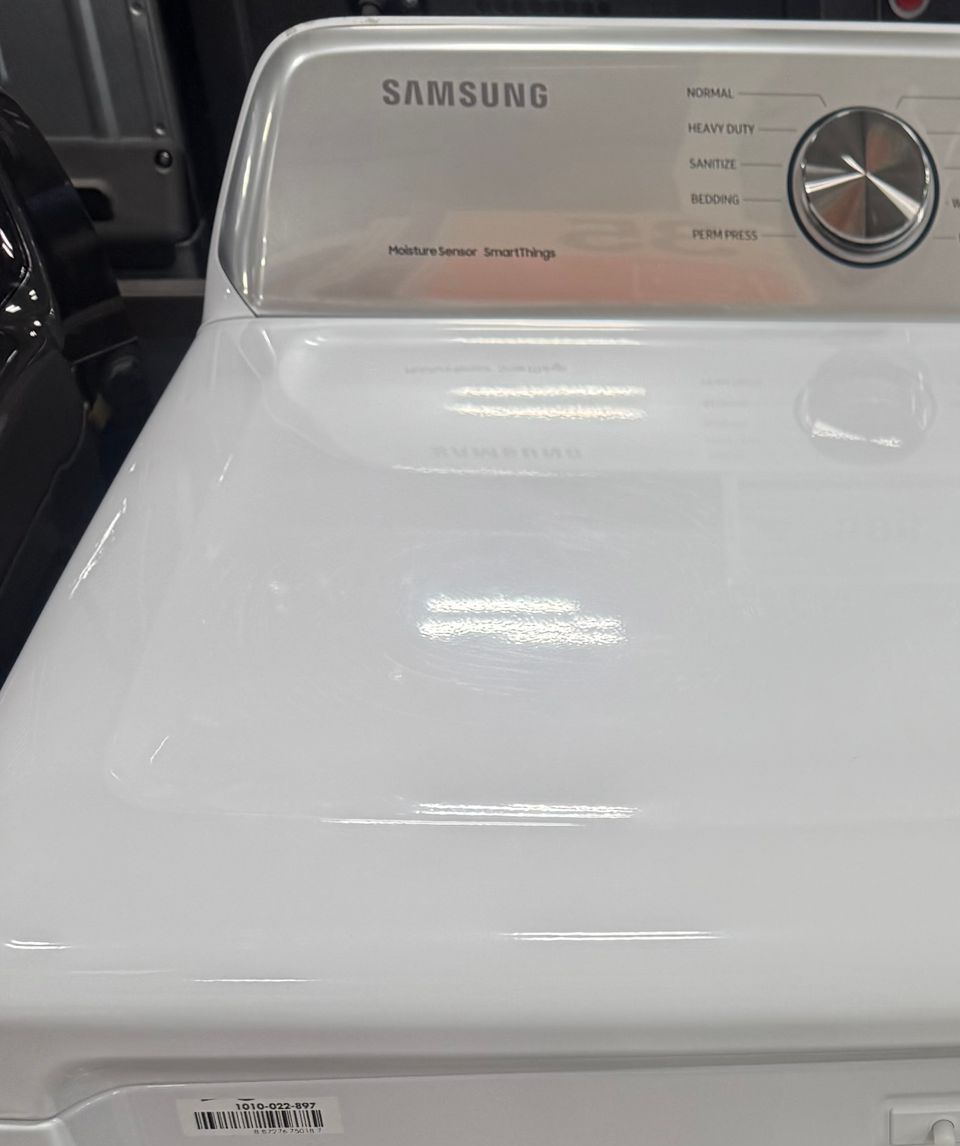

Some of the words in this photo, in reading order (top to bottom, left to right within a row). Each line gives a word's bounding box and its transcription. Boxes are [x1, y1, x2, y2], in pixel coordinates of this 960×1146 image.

[382, 79, 548, 109] SAMSUNG
[687, 88, 734, 99] NORMAL
[688, 123, 723, 134] HEAVY
[726, 123, 755, 135] DUTY
[689, 158, 737, 170] SANITIZE
[691, 194, 739, 206] BEDDING
[692, 230, 722, 241] PERM
[725, 230, 758, 241] PRESS
[388, 244, 437, 258] Moisture
[439, 246, 477, 258] Sensor
[484, 247, 556, 261] SmartThings
[236, 1102, 316, 1110] 1010-022-897
